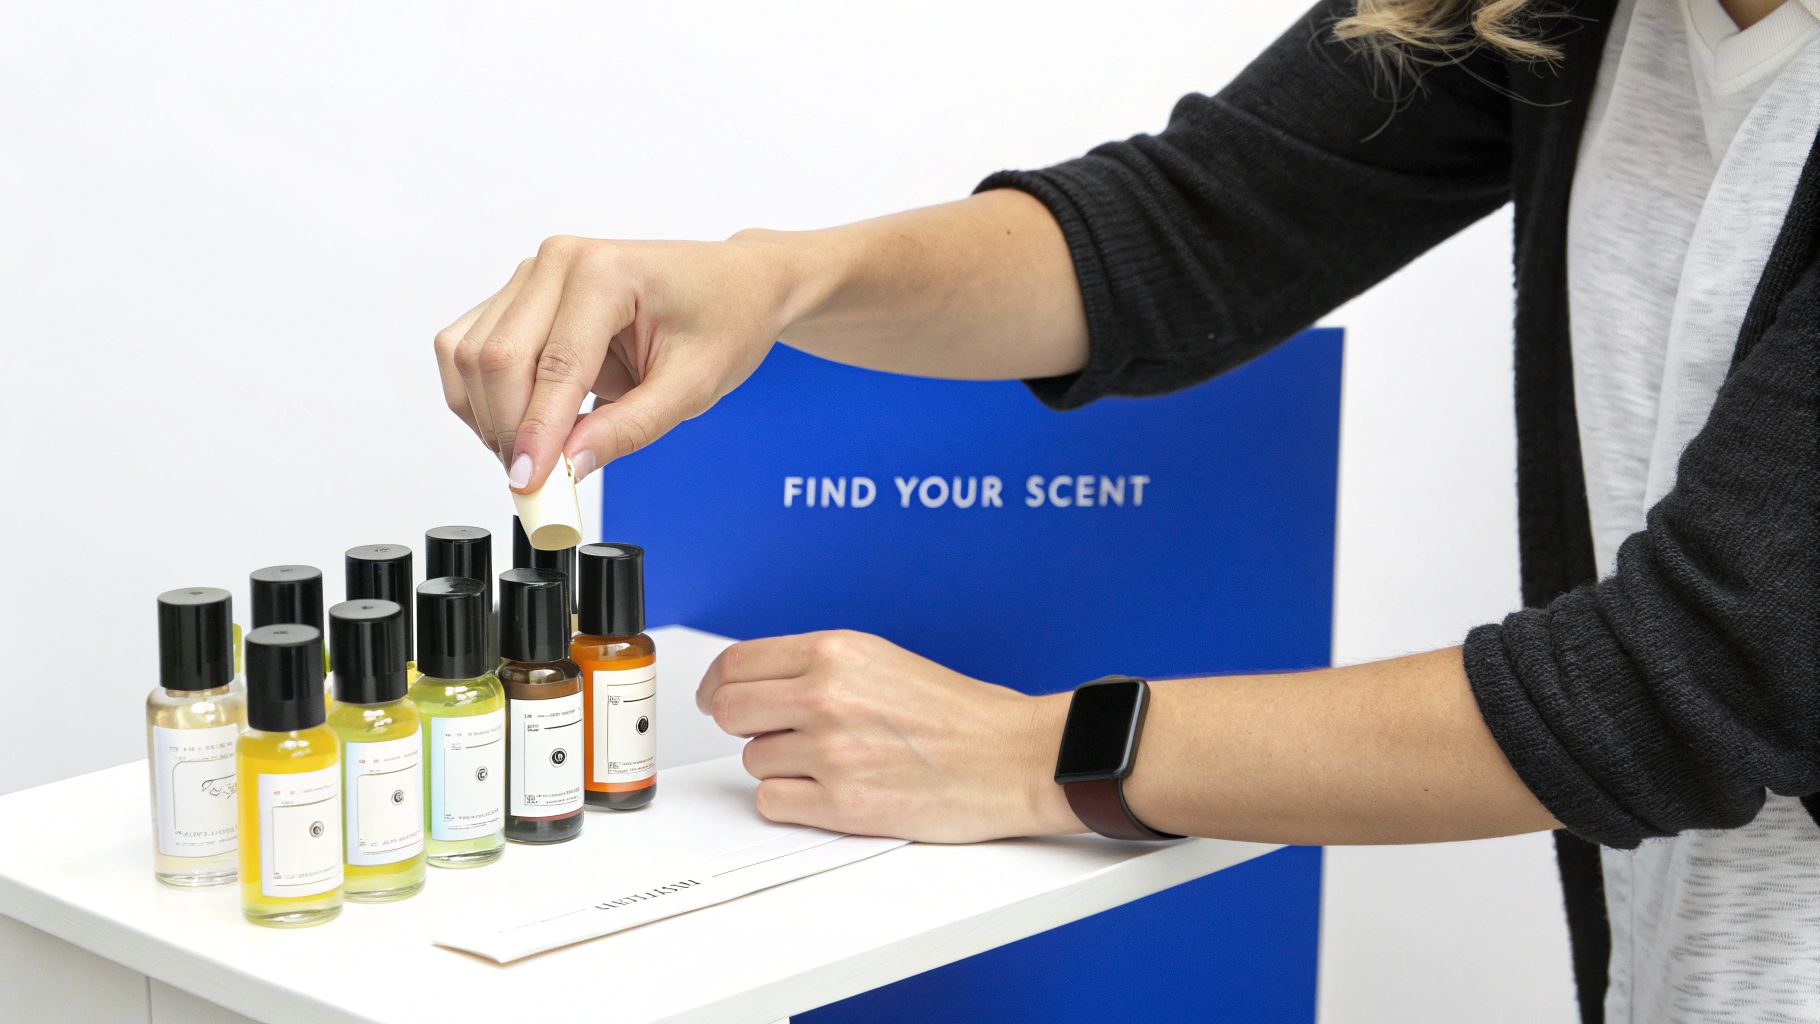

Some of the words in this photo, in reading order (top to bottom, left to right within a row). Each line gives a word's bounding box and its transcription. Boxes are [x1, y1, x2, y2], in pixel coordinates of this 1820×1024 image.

[783, 476, 877, 508] FIND
[894, 475, 1004, 508] YOUR
[1024, 475, 1151, 507] SCENT
